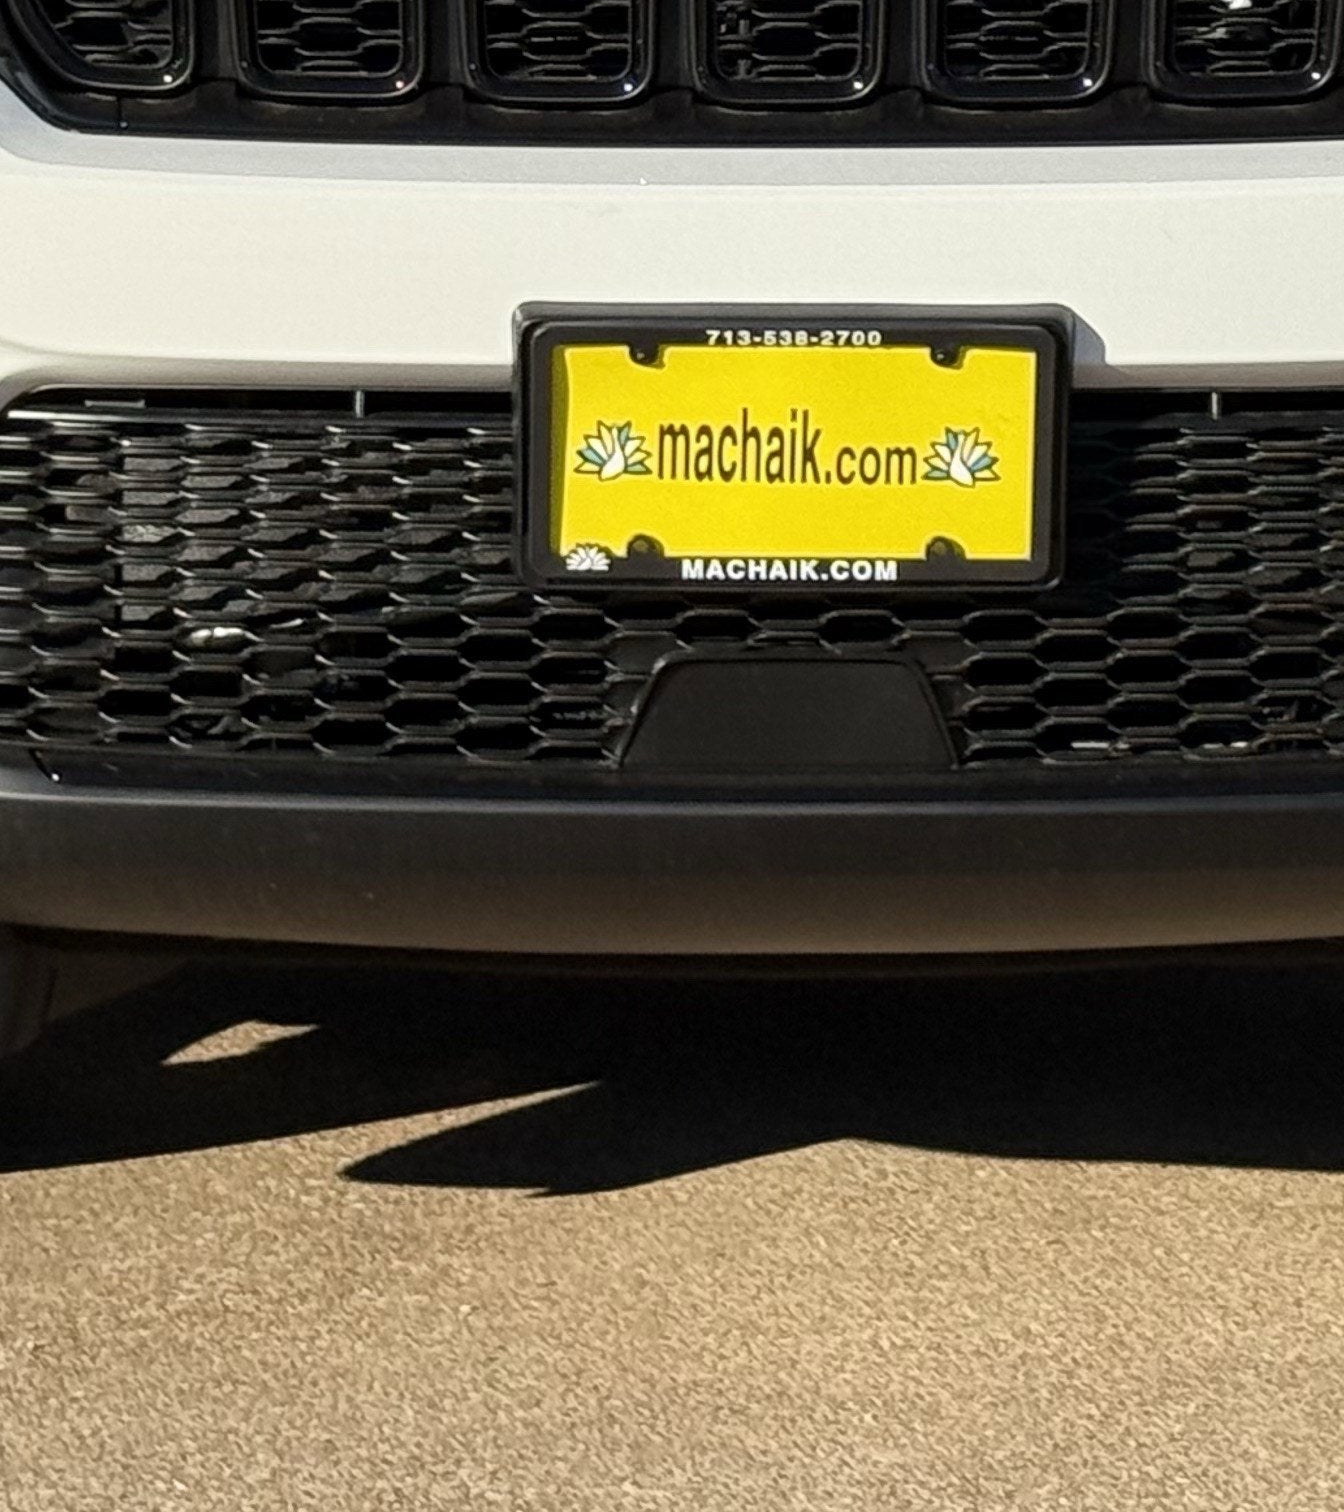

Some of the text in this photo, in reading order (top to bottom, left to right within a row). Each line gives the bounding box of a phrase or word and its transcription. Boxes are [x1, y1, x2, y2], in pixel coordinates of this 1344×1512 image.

[705, 329, 882, 346] 713-538-2700
[657, 406, 918, 485] machaik.com
[680, 558, 898, 581] MACHAIK.COM
